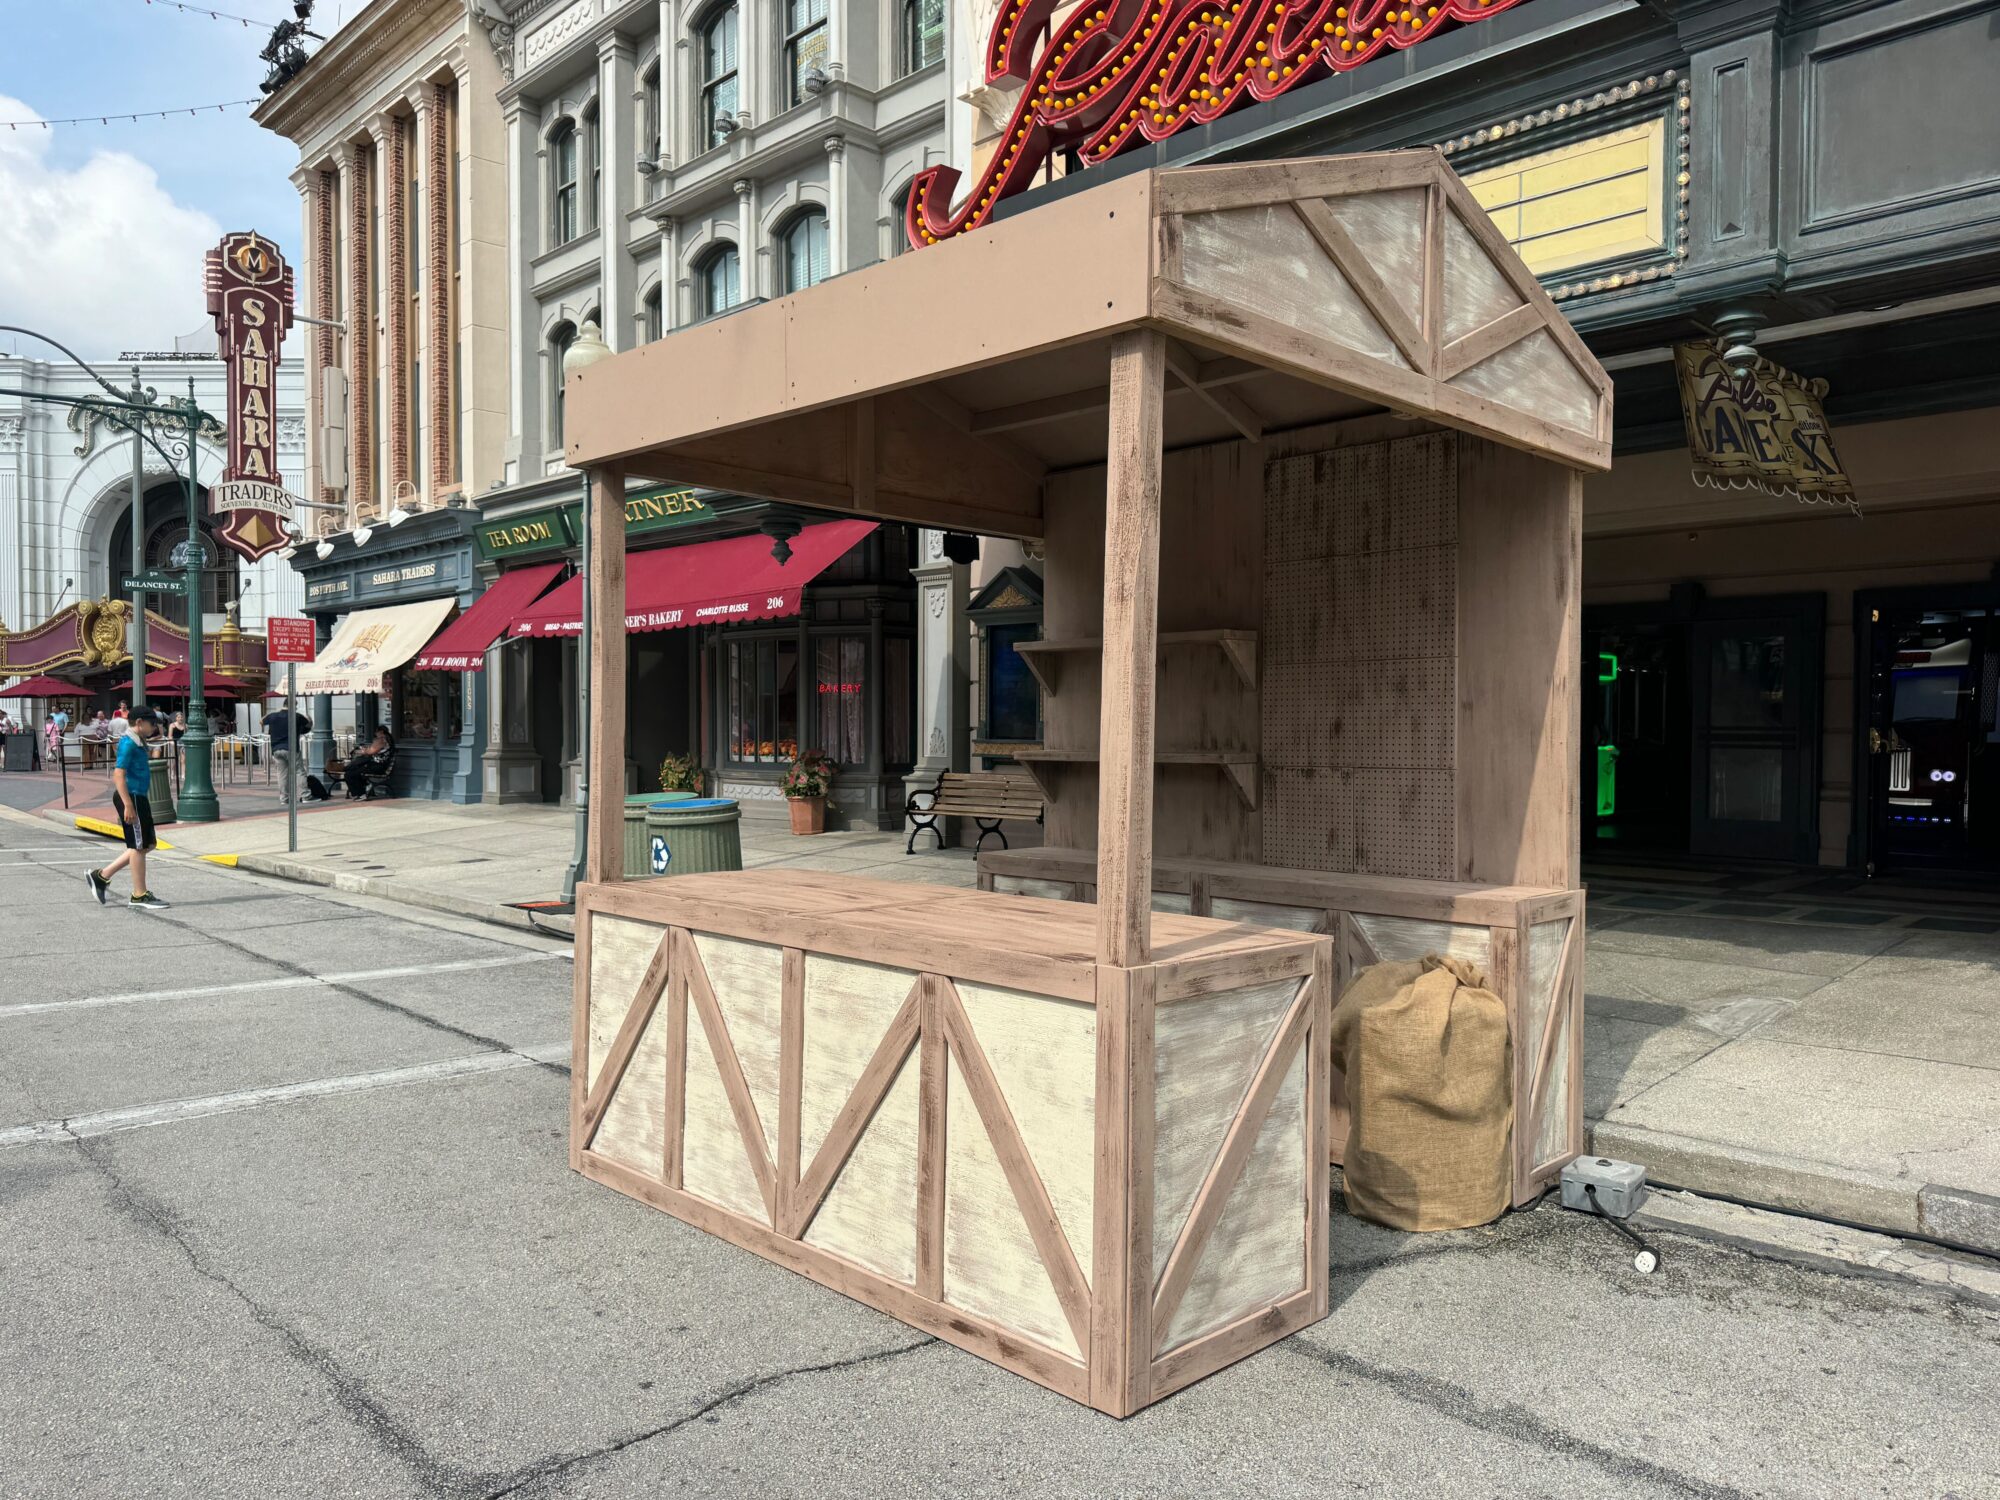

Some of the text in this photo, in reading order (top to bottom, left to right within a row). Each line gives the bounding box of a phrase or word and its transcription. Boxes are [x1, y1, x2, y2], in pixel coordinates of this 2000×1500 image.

[245, 250, 263, 272] M
[241, 298, 270, 478] SAHARA
[218, 483, 293, 510] TRADERS
[220, 500, 252, 509] SOUVENIRS
[261, 502, 288, 515] SUPPLIES
[486, 521, 552, 548] TEA ROOM
[372, 563, 436, 585] SAHARA TRADERS
[125, 580, 182, 590] DELANCEY ST.
[695, 602, 749, 617] CHARLOTTE RUSSE
[767, 596, 784, 610] 206
[283, 619, 310, 628] STANDING
[624, 609, 684, 629] NER'S BAKERY
[300, 638, 310, 646] PM
[431, 656, 468, 667] TEA ROOM
[324, 679, 349, 689] TRADERS
[819, 684, 861, 693] BAKERY
